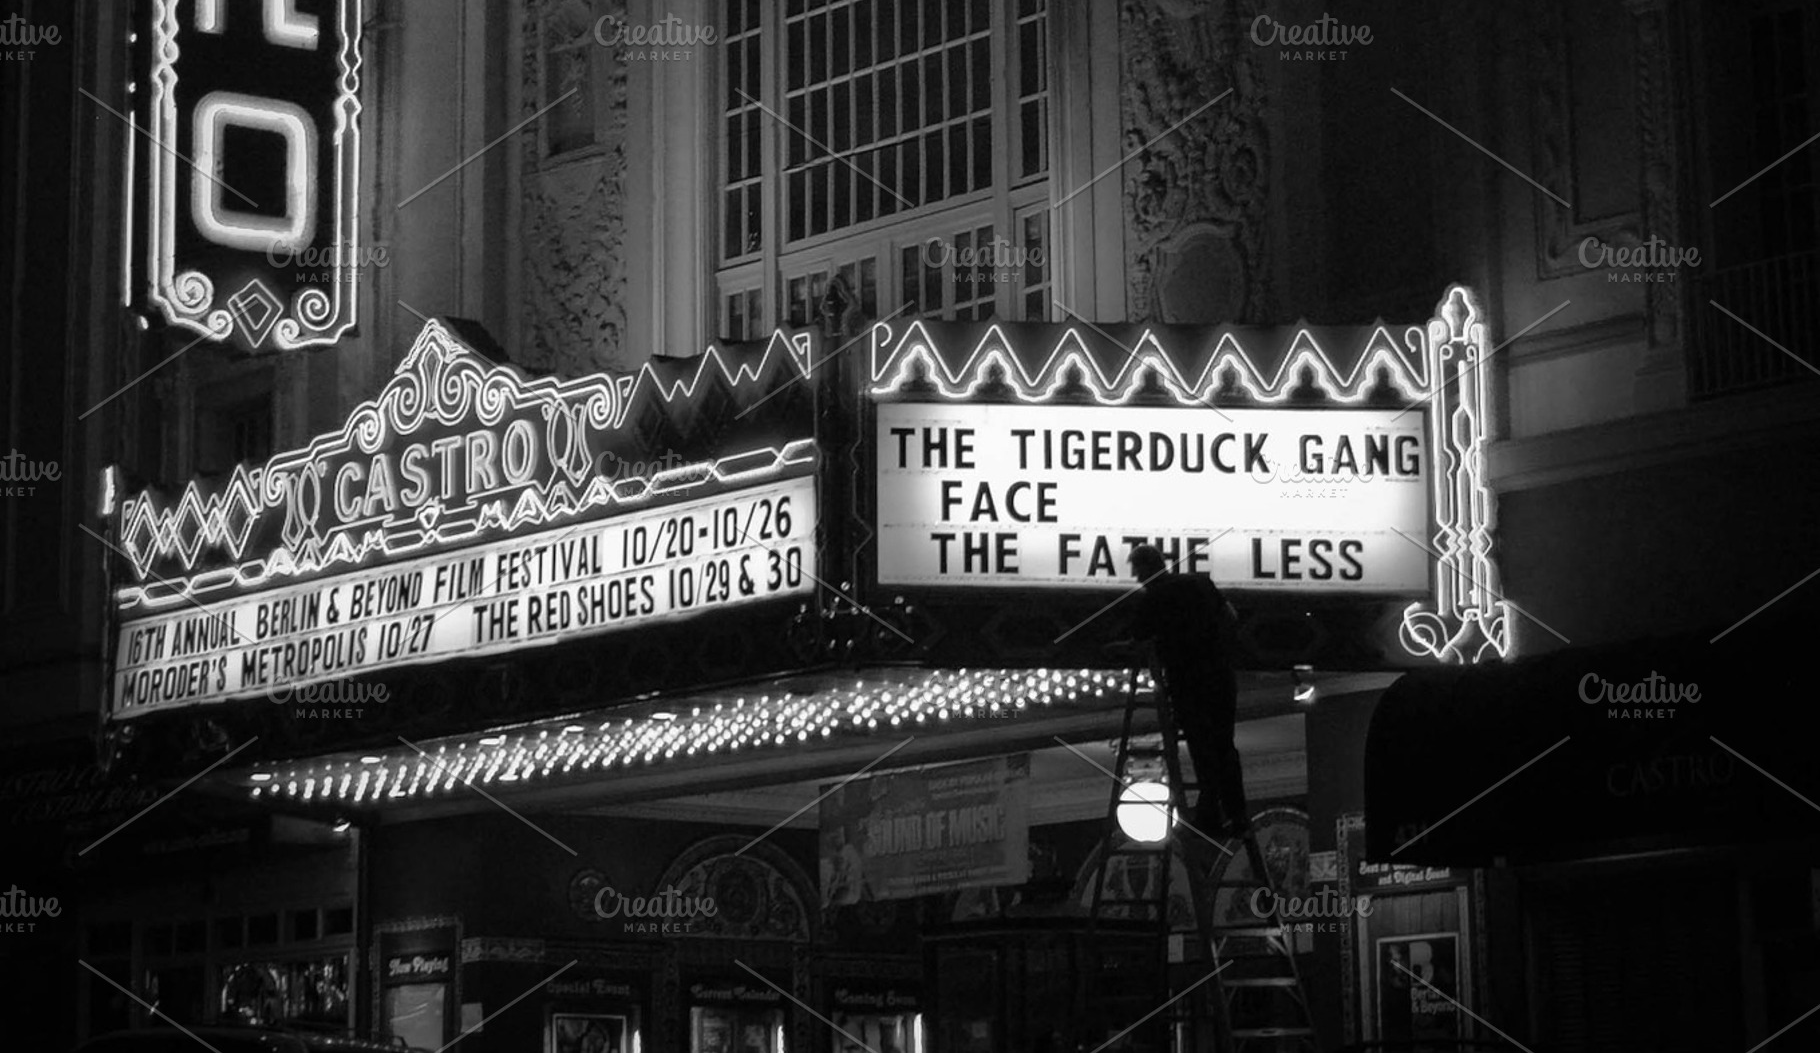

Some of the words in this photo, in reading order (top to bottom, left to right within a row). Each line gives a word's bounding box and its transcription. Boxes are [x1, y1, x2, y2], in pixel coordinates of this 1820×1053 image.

[334, 419, 540, 523] CASTRO
[890, 427, 975, 469] THE
[1012, 429, 1270, 474] TIGERDUCK
[1300, 434, 1420, 476] GANG
[942, 480, 1058, 523] FACE
[128, 624, 167, 665] 16TH
[171, 610, 240, 657] ANNUAL
[256, 591, 321, 640] BERLIN
[327, 587, 340, 624] &
[350, 571, 423, 621] BEYOND
[433, 557, 485, 604] FILM
[496, 535, 602, 593] FESTIVAL
[622, 496, 792, 568] 10/20-10/26
[931, 532, 1018, 575] THE
[1252, 538, 1364, 582] LESS
[121, 656, 227, 708] MORODER'S
[240, 627, 368, 688] METROPOLIS
[377, 614, 436, 662] 10/27
[473, 599, 520, 644] THE
[527, 590, 571, 635] RED
[577, 575, 655, 627] SHOES
[669, 559, 730, 610] 10/29
[738, 553, 756, 596] &
[766, 546, 802, 591] 30
[1606, 750, 1735, 798] CASTRO
